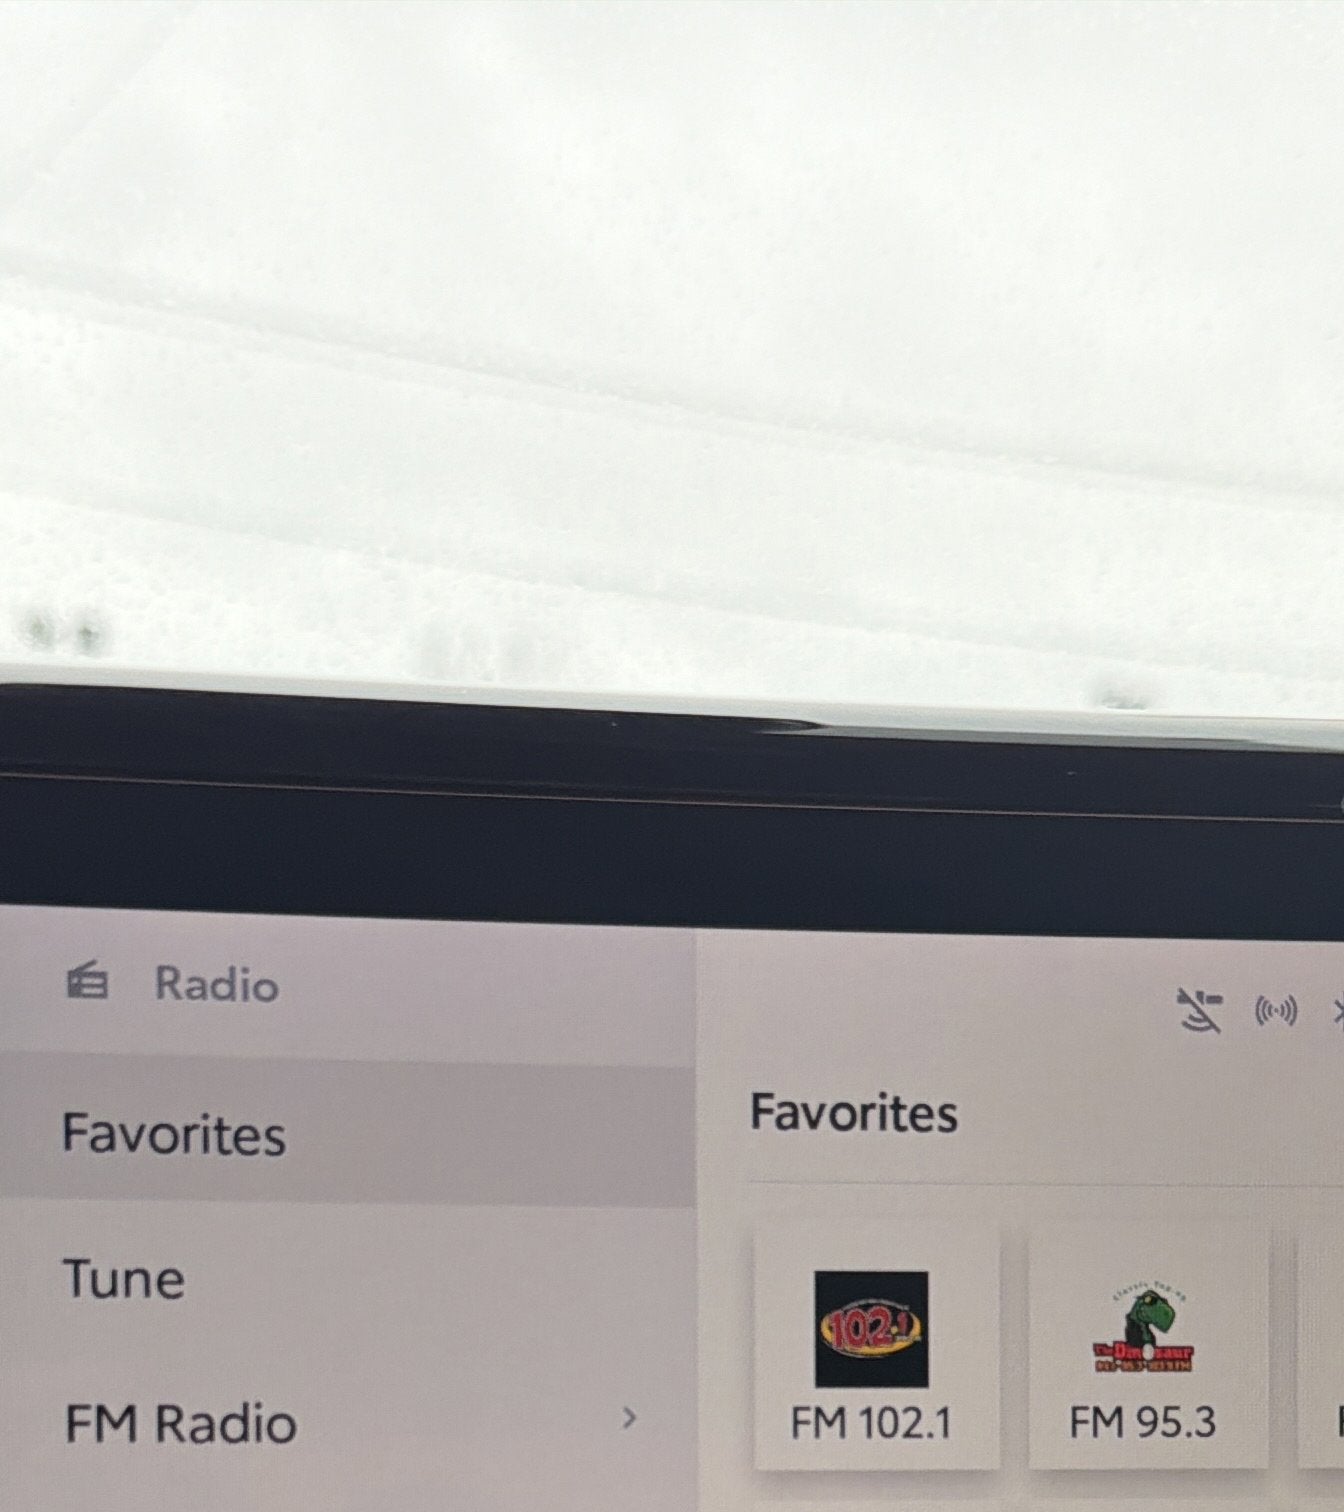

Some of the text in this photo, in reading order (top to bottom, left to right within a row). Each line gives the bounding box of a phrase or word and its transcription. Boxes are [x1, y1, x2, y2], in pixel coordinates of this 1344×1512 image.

[156, 964, 279, 1003] Radio
[752, 1091, 958, 1134] Favorites
[63, 1111, 286, 1157] Favorites
[62, 1258, 185, 1300] Tune
[67, 1401, 297, 1445] FM Radio
[792, 1405, 949, 1440] FM 102.1
[1071, 1405, 1216, 1439] FM 95.3
